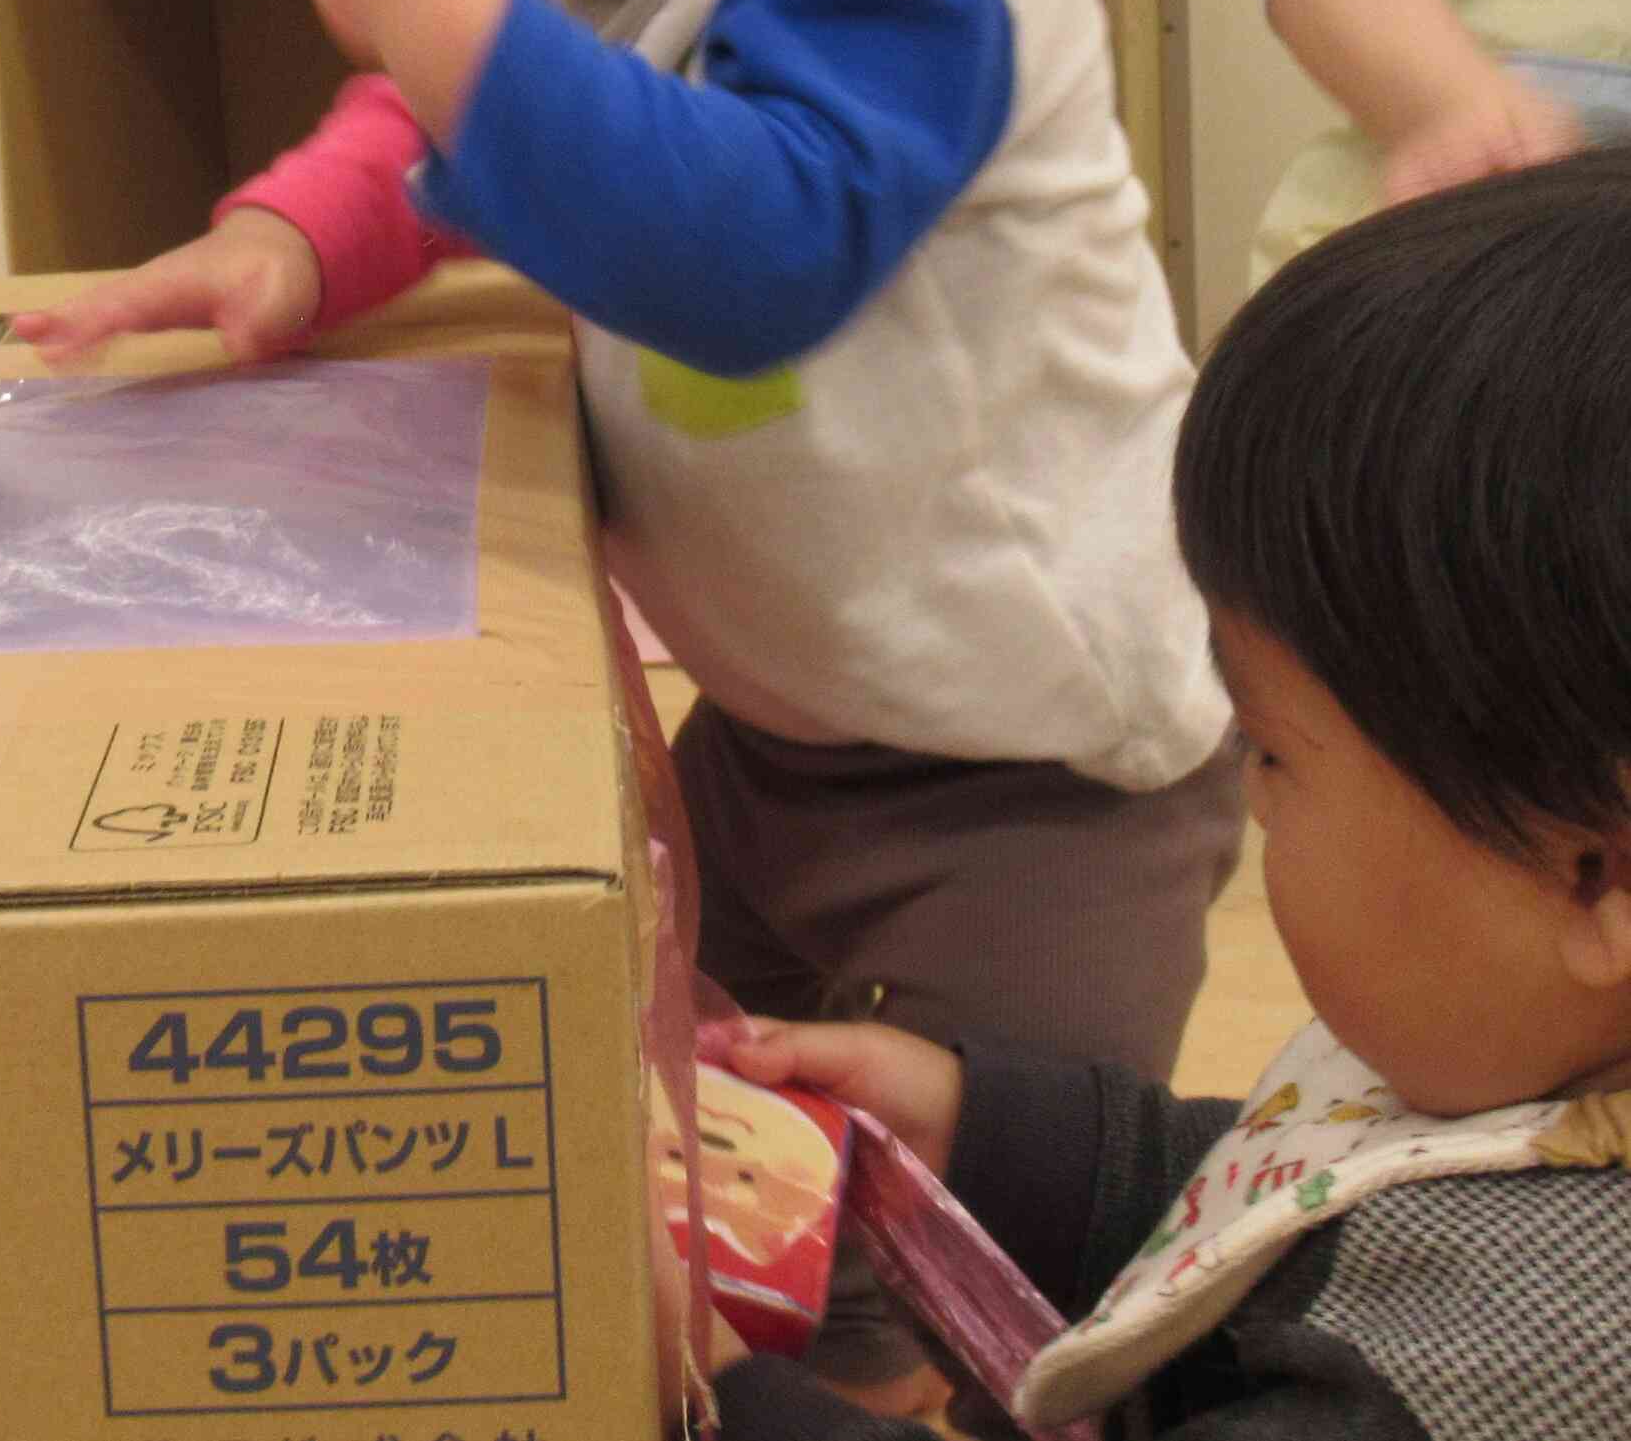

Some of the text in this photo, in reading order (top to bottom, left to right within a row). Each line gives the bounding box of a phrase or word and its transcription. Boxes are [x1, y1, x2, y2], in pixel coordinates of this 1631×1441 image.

[128, 998, 503, 1085] 44295
[111, 1116, 534, 1184] メリーズパンツ L
[223, 1219, 434, 1293] 54枚
[206, 1323, 457, 1396] 3パック
